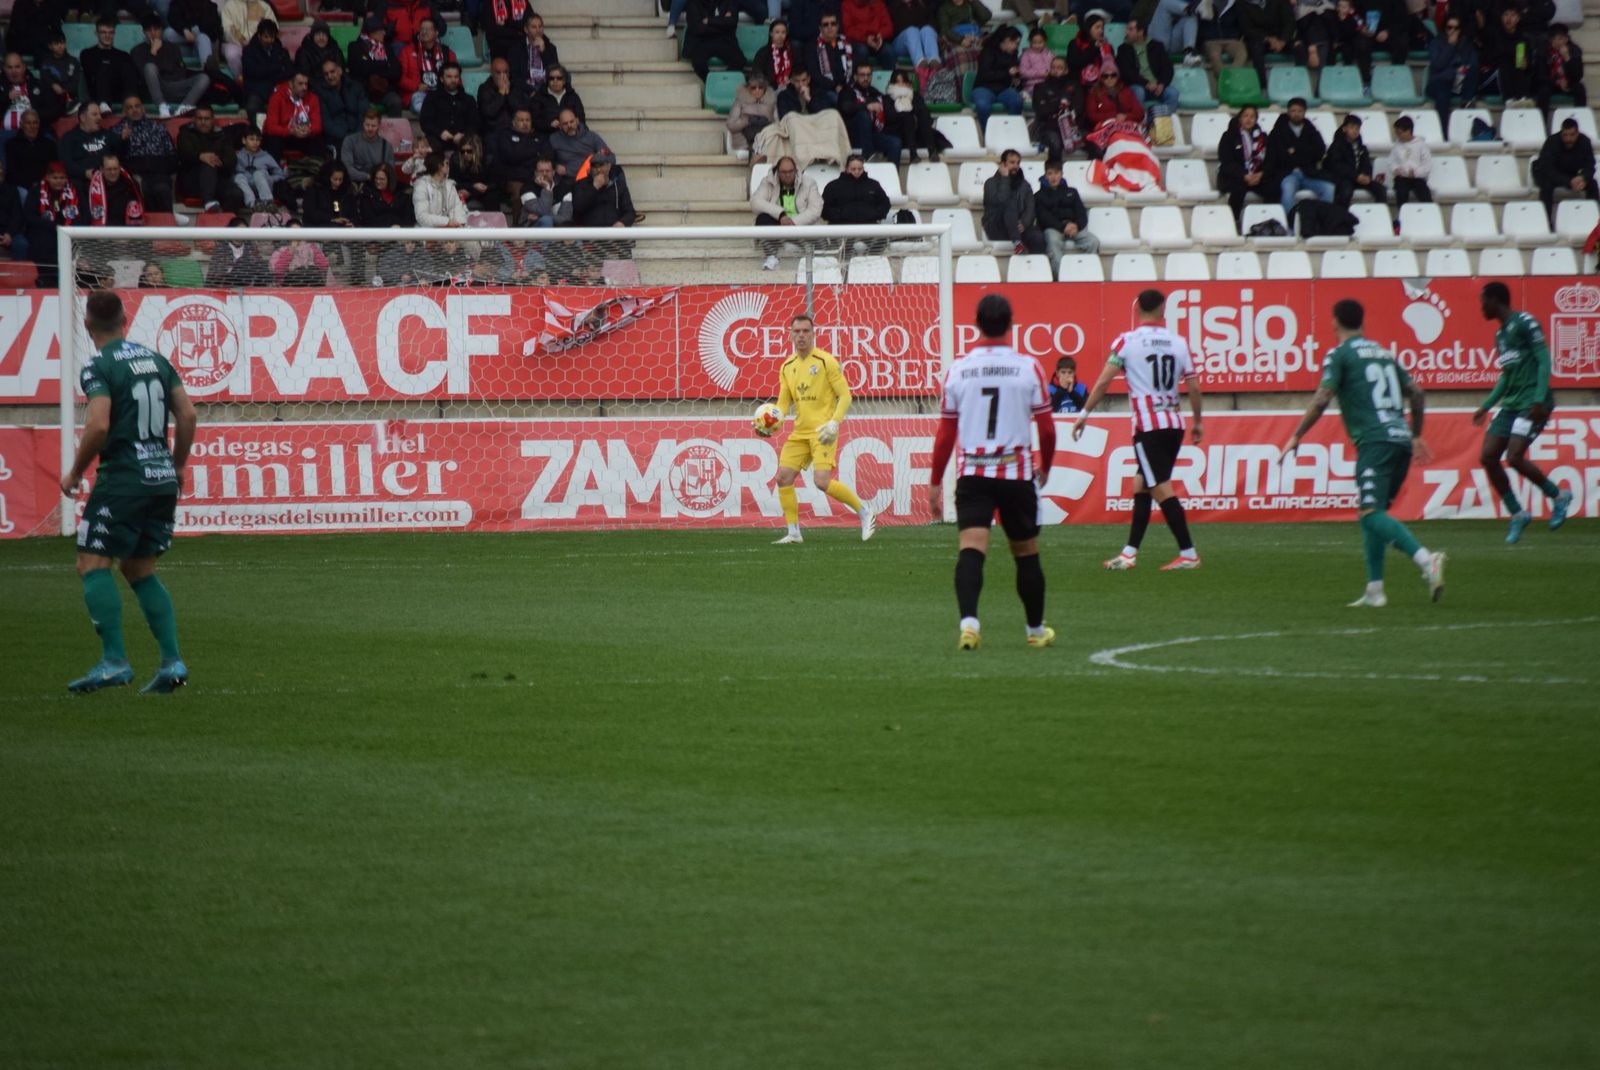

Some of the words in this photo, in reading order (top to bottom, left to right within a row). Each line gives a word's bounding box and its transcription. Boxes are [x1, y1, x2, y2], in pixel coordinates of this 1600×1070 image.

[728, 324, 910, 359] CETRO
[1163, 287, 1298, 352] fisio
[376, 293, 512, 395] CF
[1187, 334, 1320, 382] eadapt
[1145, 353, 1176, 392] 10
[1365, 362, 1403, 410] 21
[981, 386, 1000, 440] 7
[171, 436, 294, 461] odegas
[385, 432, 427, 454] del
[177, 444, 459, 500] umiller
[838, 436, 937, 516] CF
[178, 506, 460, 529] .bodegasdelsumiller.com
[1247, 494, 1361, 510] CLIMATIZACIO
